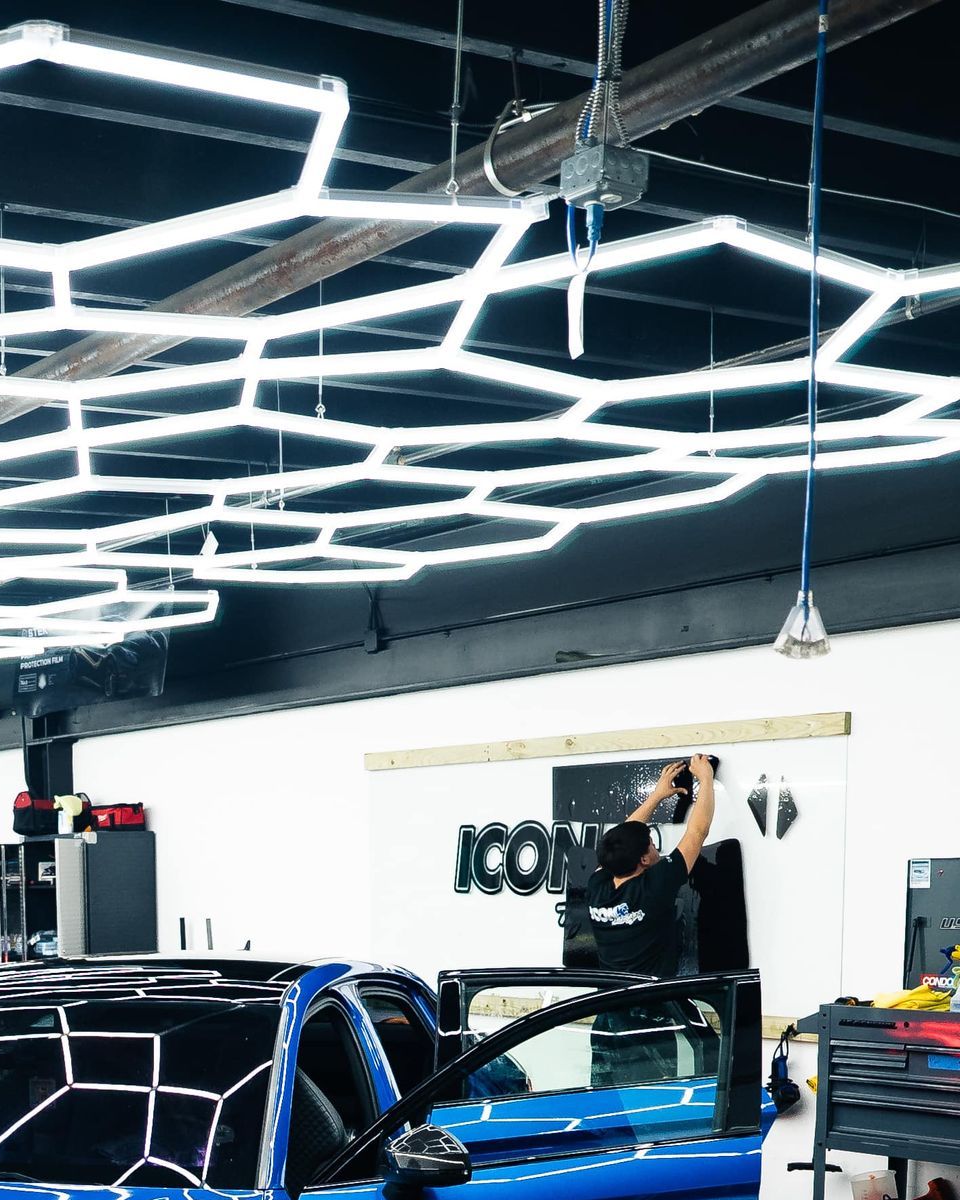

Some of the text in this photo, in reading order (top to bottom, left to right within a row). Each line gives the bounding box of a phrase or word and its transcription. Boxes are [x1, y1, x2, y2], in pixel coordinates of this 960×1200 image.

[20, 656, 64, 670] PROTECTION FILM
[454, 820, 662, 895] ICON
[922, 976, 954, 988] CONDO
